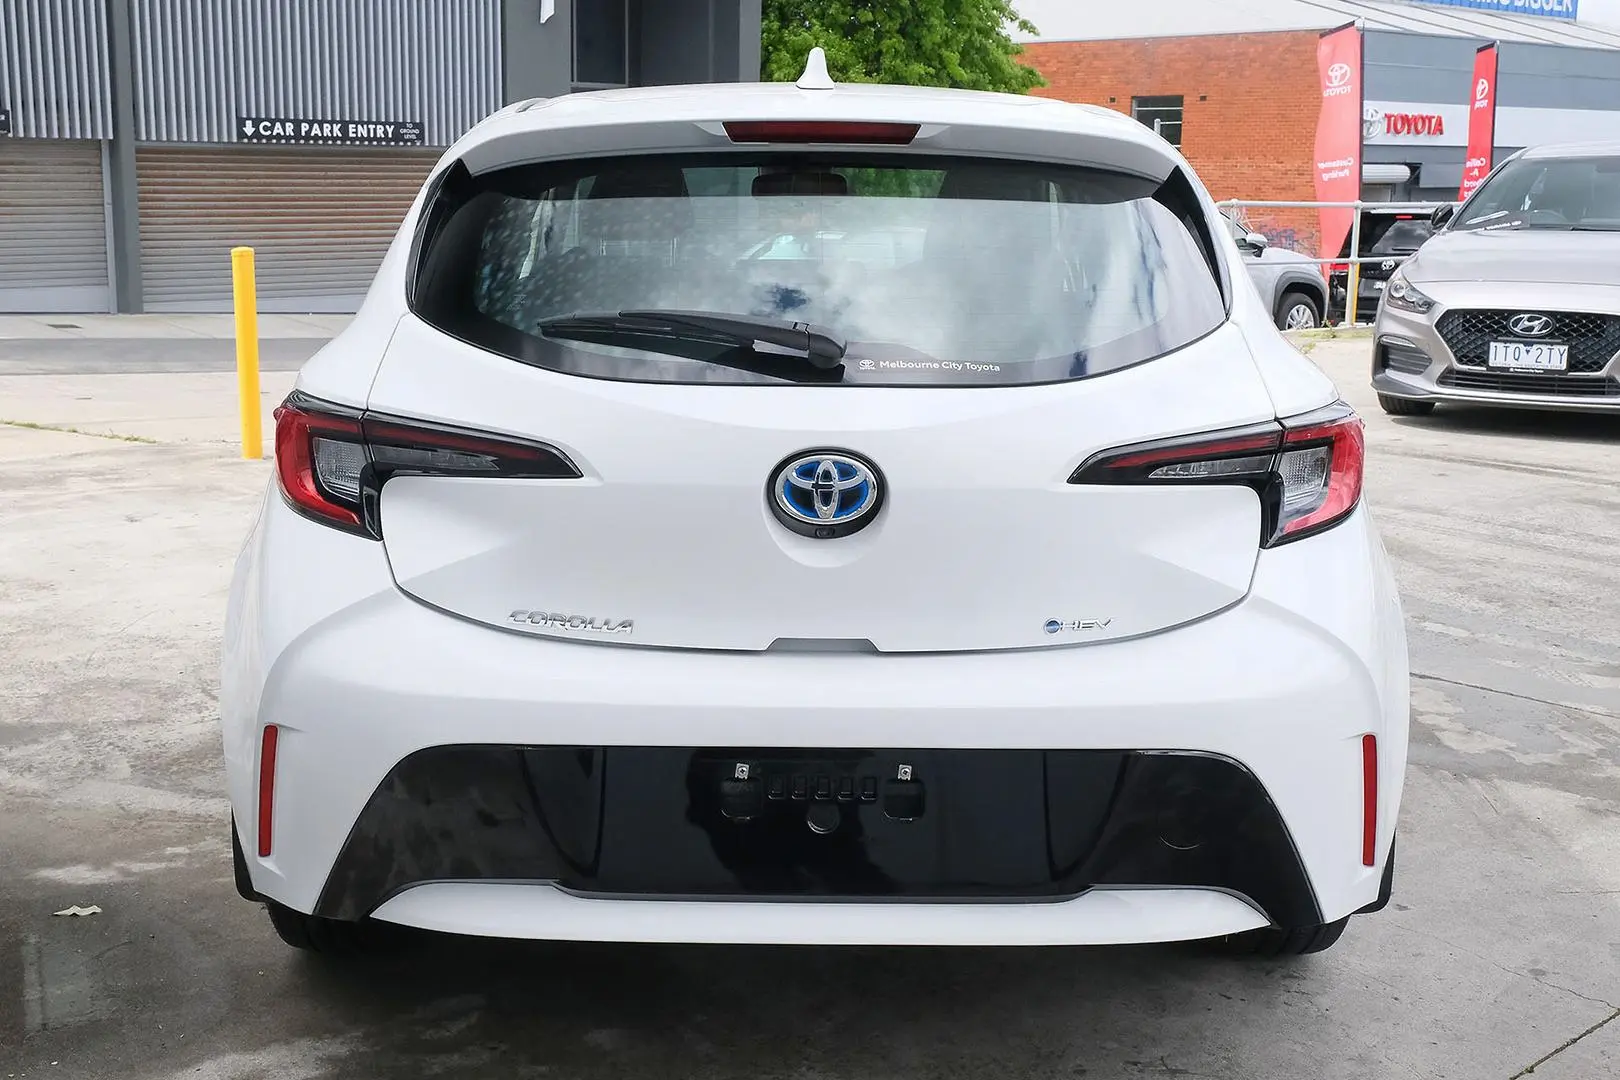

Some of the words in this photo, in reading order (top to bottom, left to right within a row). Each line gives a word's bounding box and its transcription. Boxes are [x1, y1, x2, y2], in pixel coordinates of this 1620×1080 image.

[258, 121, 295, 137] CAR
[301, 122, 343, 137] PARK
[348, 124, 395, 138] ENTRY
[1384, 112, 1445, 136] TOYOTA
[879, 360, 940, 369] Melbourne
[941, 361, 963, 371] City
[964, 362, 1001, 372] Toyota
[508, 609, 635, 634] COROLLA
[1060, 619, 1113, 632] HEV
